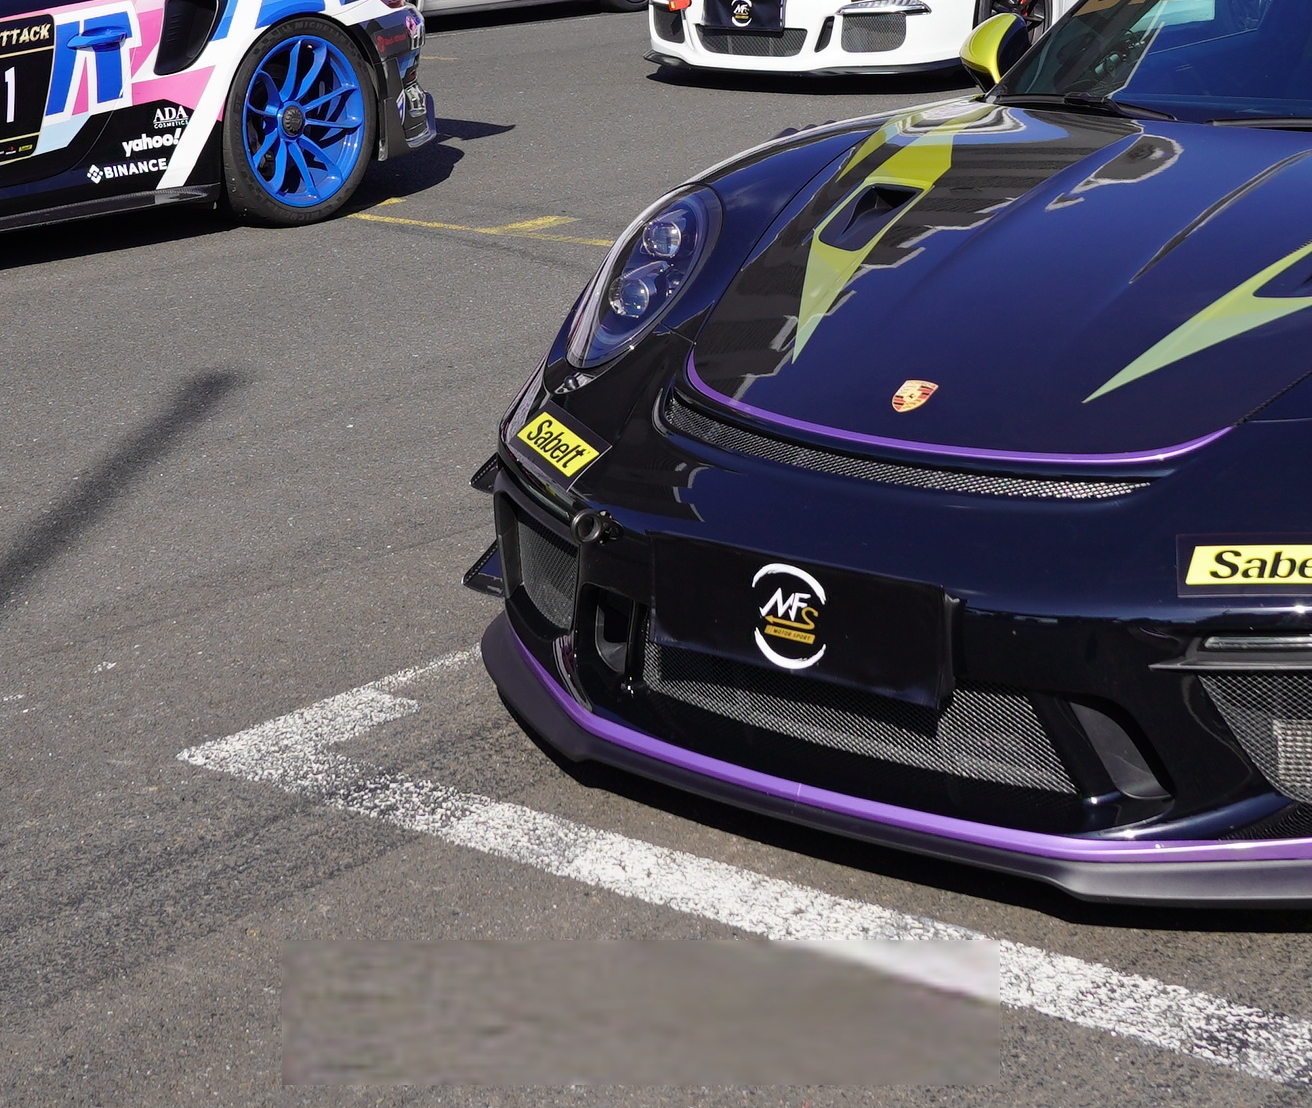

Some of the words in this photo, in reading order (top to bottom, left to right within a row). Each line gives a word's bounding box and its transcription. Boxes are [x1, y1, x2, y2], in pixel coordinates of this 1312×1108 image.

[153, 105, 189, 122] ADA
[154, 120, 189, 130] COSMETICS
[122, 127, 182, 158] yahoo!
[104, 158, 168, 179] BINANCE
[526, 419, 587, 469] Sabelt
[772, 627, 792, 638] MOTOR
[792, 631, 812, 642] SPORT
